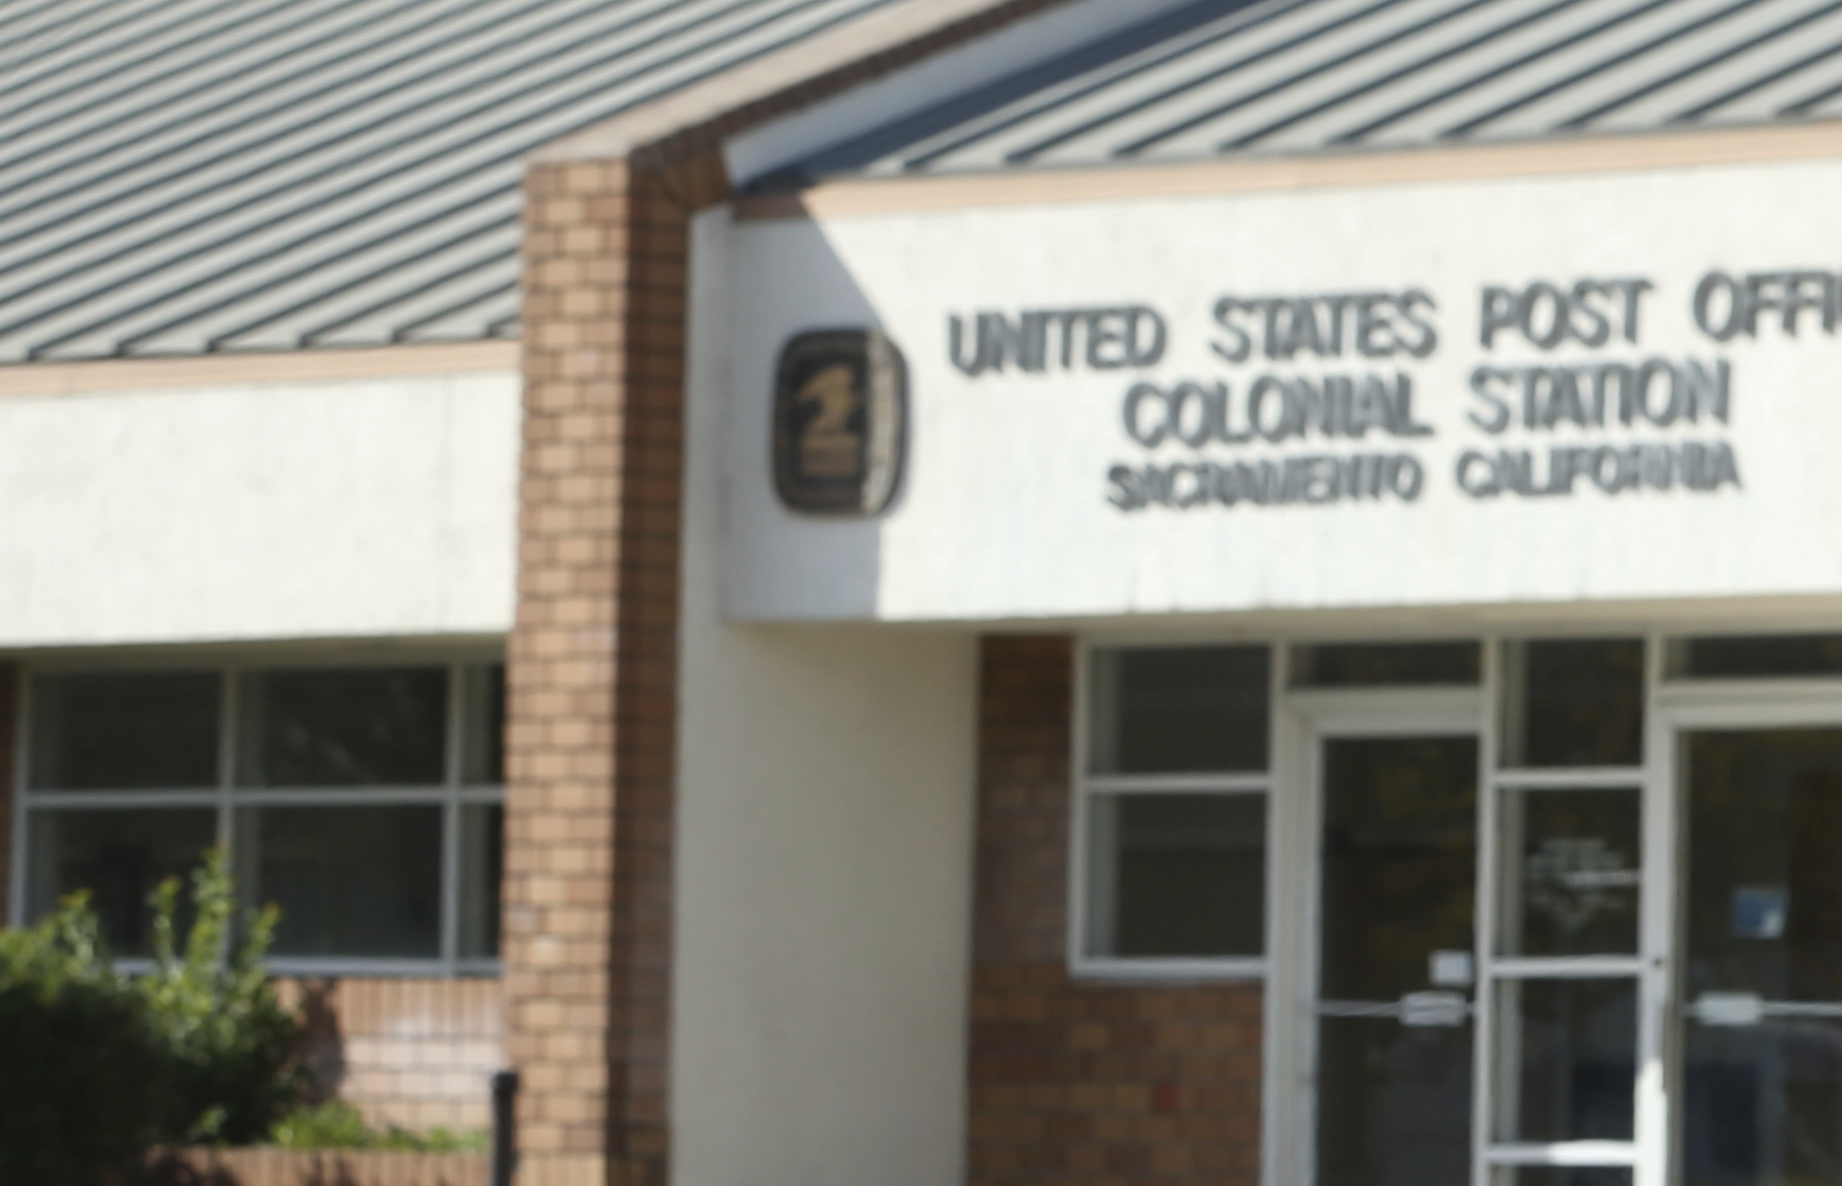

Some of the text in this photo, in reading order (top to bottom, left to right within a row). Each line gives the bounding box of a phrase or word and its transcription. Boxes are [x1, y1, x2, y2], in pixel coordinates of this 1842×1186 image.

[946, 304, 1168, 378] UNITED
[1210, 290, 1440, 366] STATES
[1478, 276, 1653, 351] POST
[1120, 358, 1732, 450] COLONIAL STATION
[1106, 441, 1742, 514] SACRAMENTO CALIFORNIA
